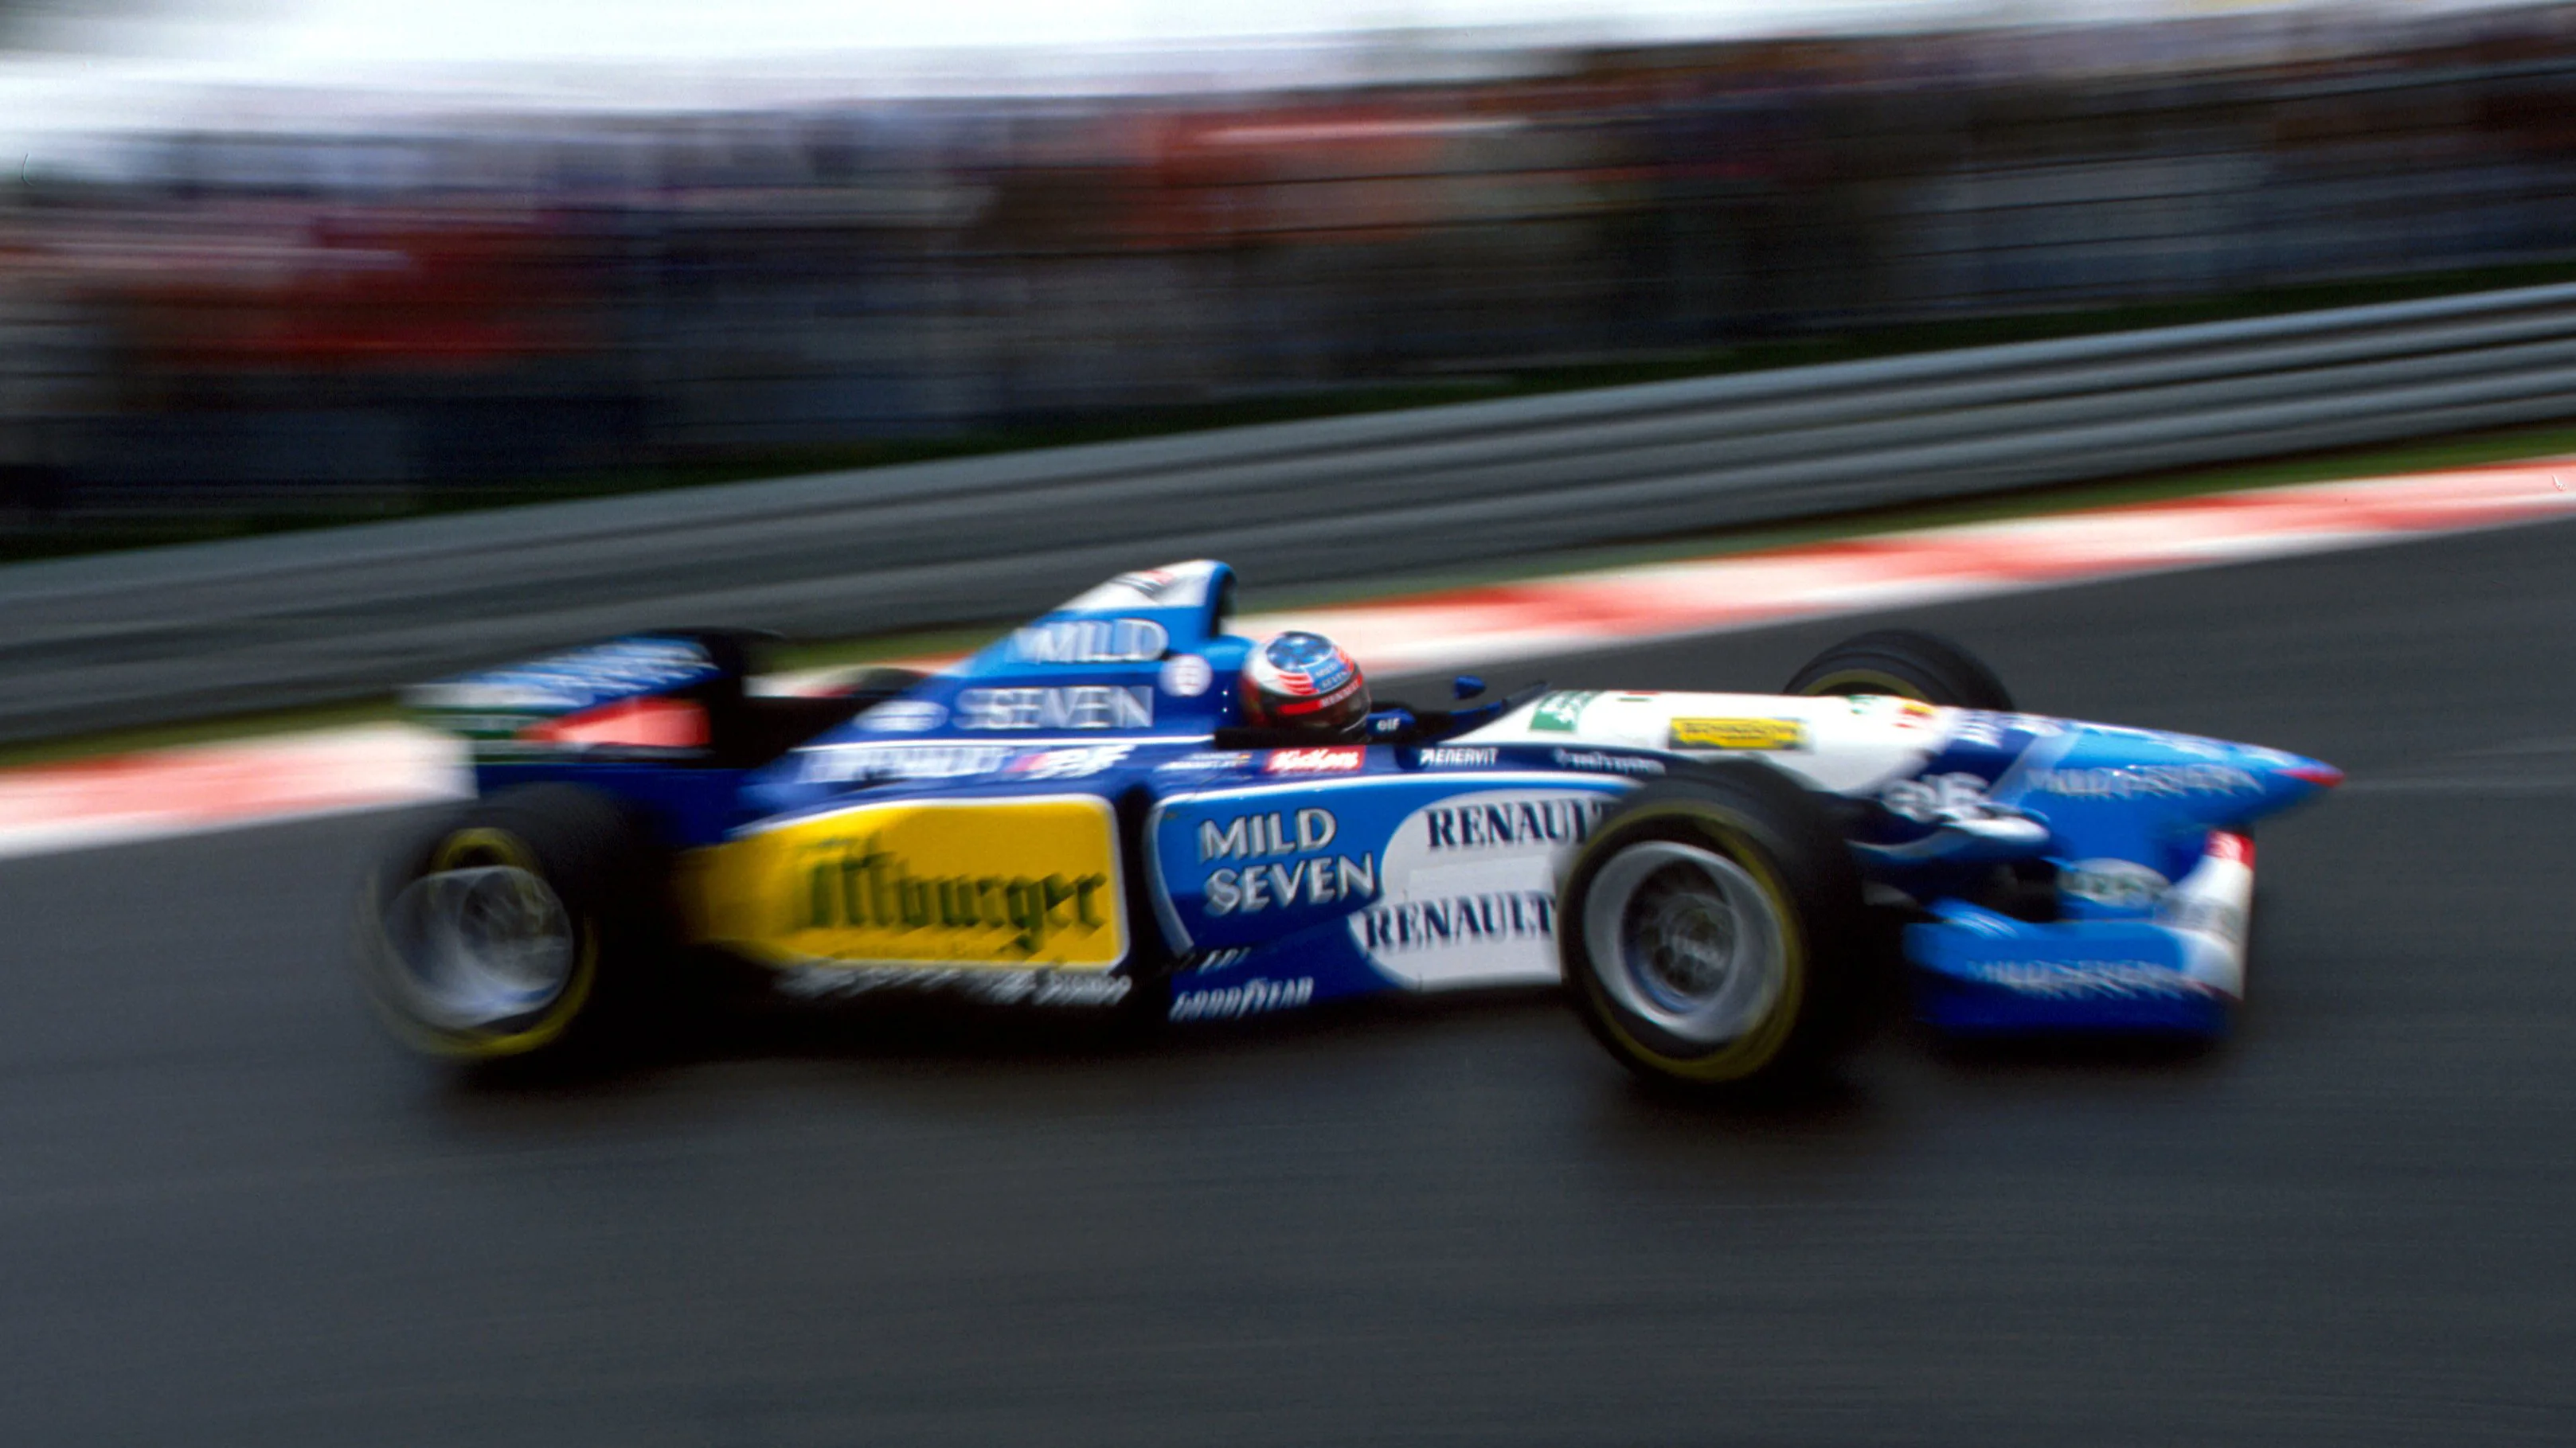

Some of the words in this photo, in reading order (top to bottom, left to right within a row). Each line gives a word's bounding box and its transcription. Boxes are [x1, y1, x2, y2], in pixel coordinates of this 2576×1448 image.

[956, 685, 1153, 729] SEVEN
[1377, 718, 1400, 731] elf
[1198, 807, 1337, 861] MILD
[1425, 798, 1602, 850] RENAUL
[1205, 852, 1376, 915] SEVEN
[1358, 889, 1557, 951] RENAULT
